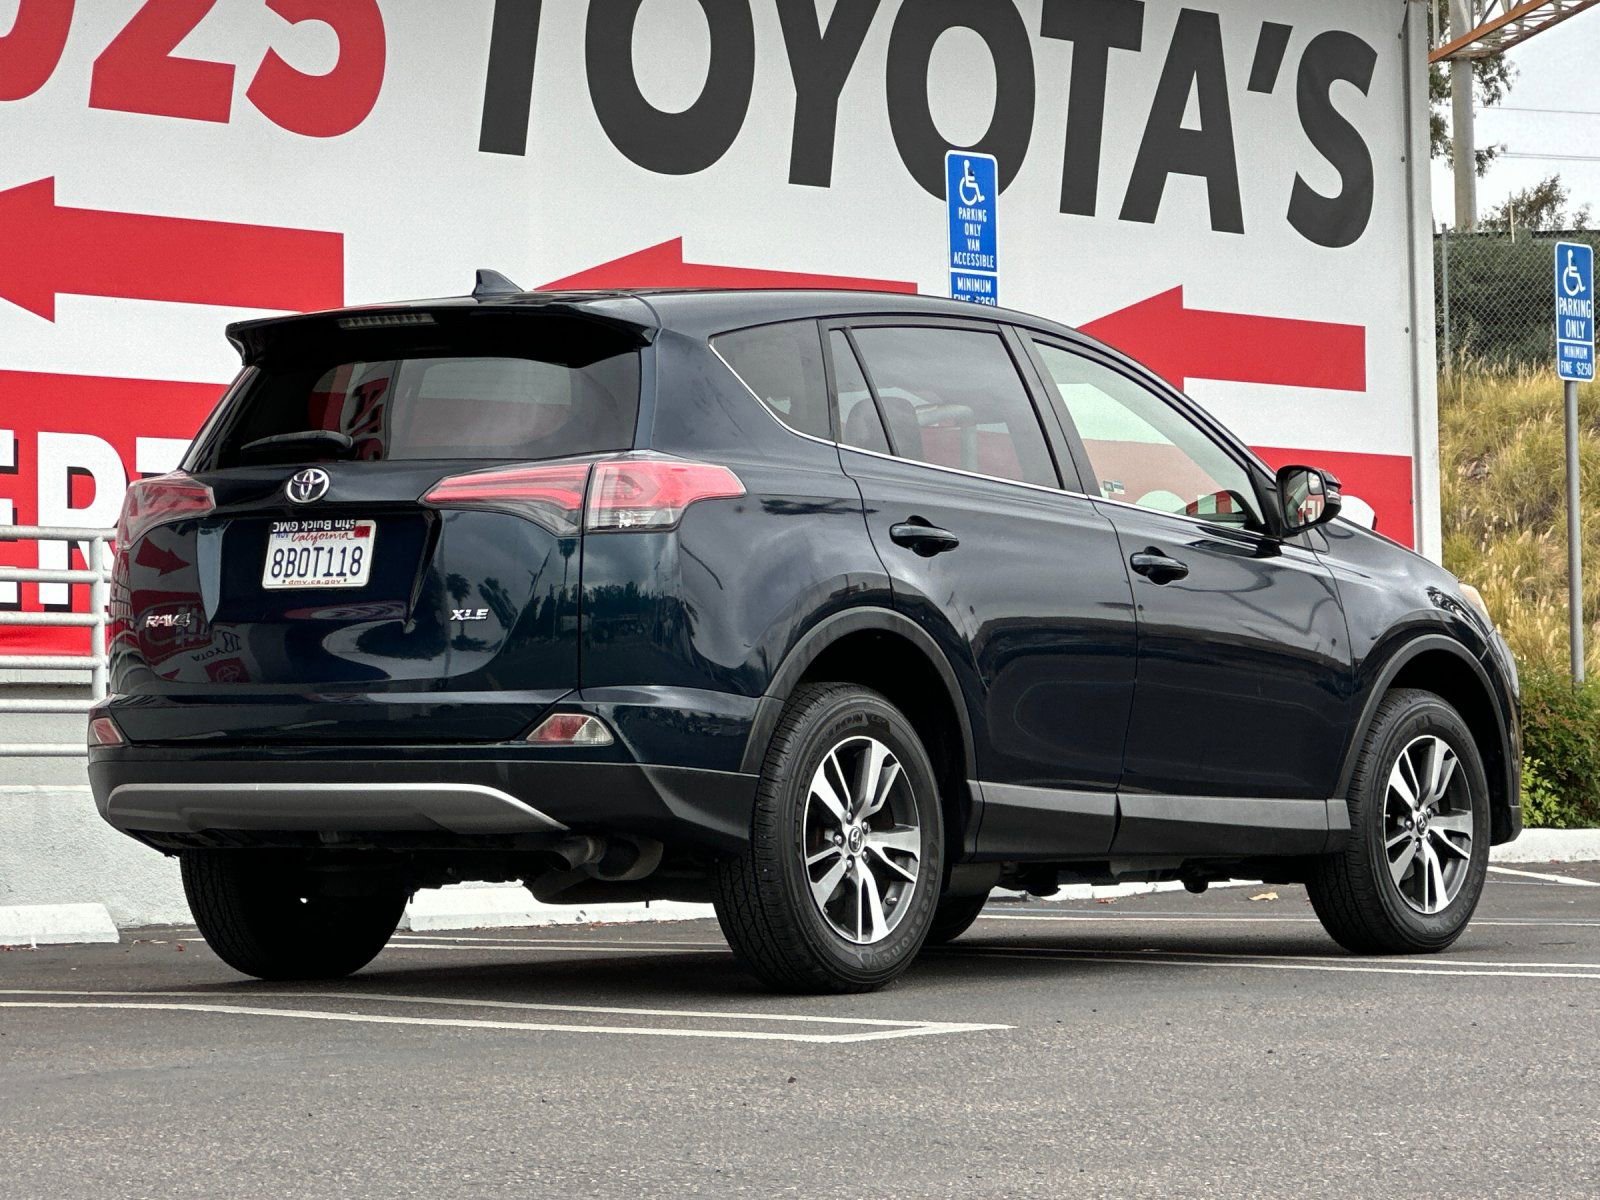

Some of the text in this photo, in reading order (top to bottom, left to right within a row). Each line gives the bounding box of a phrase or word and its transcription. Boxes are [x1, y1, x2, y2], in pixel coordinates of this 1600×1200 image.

[958, 206, 988, 223] PARKING
[964, 223, 982, 237] ONLY
[967, 238, 980, 251] VAN
[953, 251, 995, 269] ACCESSIBLE
[957, 276, 992, 294] MINIMUM
[1559, 296, 1592, 319] PARKING
[1565, 318, 1586, 339] ONLY
[1564, 345, 1588, 360] MINIMUM
[1560, 360, 1592, 376] FINE $250
[272, 521, 299, 532] GMC
[301, 519, 332, 532] Buick
[291, 531, 353, 546] California
[271, 545, 364, 578] 8BOT118
[145, 612, 191, 628] RAV4
[450, 608, 489, 621] XLE
